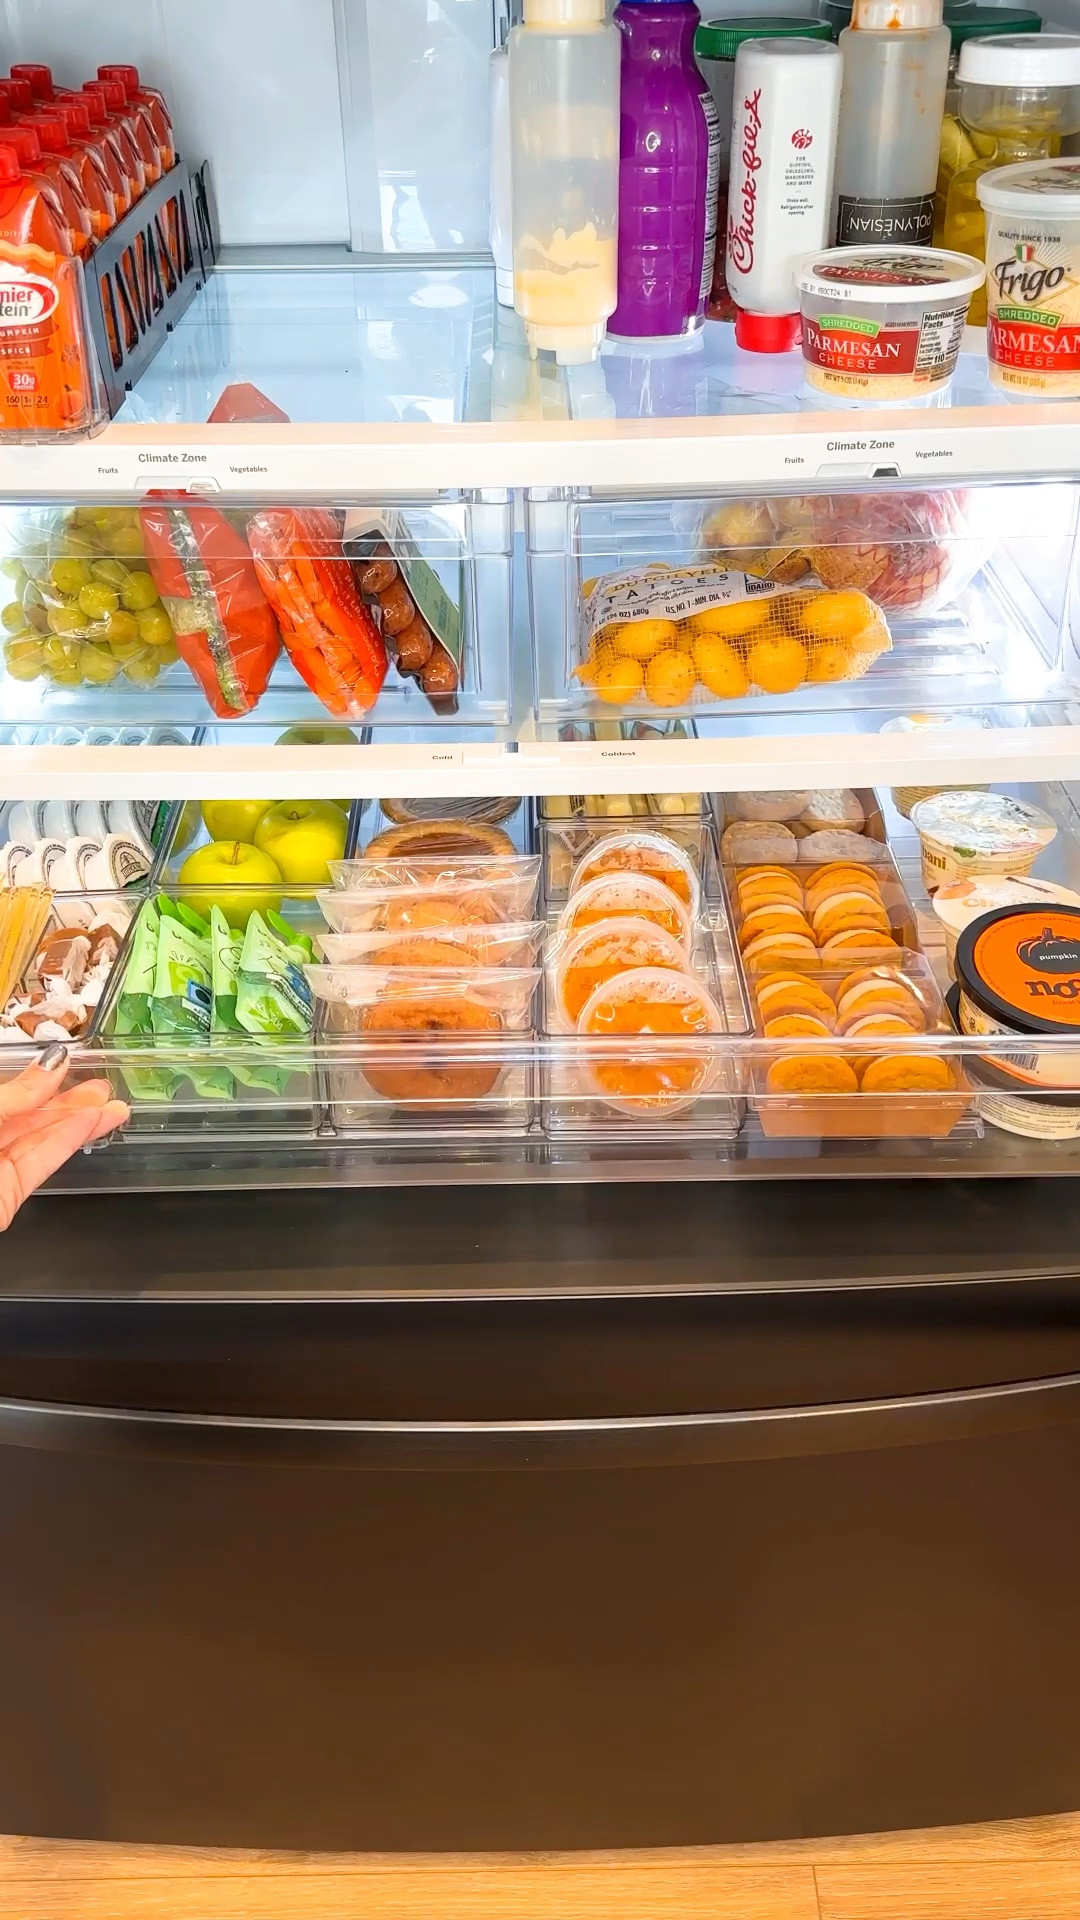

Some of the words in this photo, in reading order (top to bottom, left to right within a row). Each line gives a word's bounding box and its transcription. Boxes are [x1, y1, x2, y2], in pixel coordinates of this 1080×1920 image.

[729, 88, 762, 274] Chick-fil-A
[849, 213, 932, 232] POLYNESIAN
[998, 230, 1020, 241] QUALITY
[1021, 234, 1042, 242] SINCE
[1043, 235, 1061, 243] 1938
[994, 259, 1065, 302] Frigo
[924, 310, 955, 322] Nutrition
[999, 307, 1057, 326] SHREDDED
[821, 318, 875, 334] SHREDDED
[923, 320, 944, 329] Facts
[806, 327, 902, 358] PARMESAN
[818, 352, 878, 370] CHEESE
[934, 353, 945, 364] 110
[995, 348, 1055, 367] CHEESE
[13, 373, 35, 386] 30g
[5, 395, 19, 404] 160
[37, 395, 48, 404] 24
[826, 440, 867, 451] Climate
[868, 439, 895, 449] Zone
[138, 453, 180, 463] Climate
[181, 453, 207, 463] Zone
[915, 450, 954, 459] Vegetables
[229, 466, 268, 474] Vegetables
[748, 582, 771, 592] IDAHO
[632, 607, 650, 617] 680g
[1039, 953, 1079, 961] pumpkin
